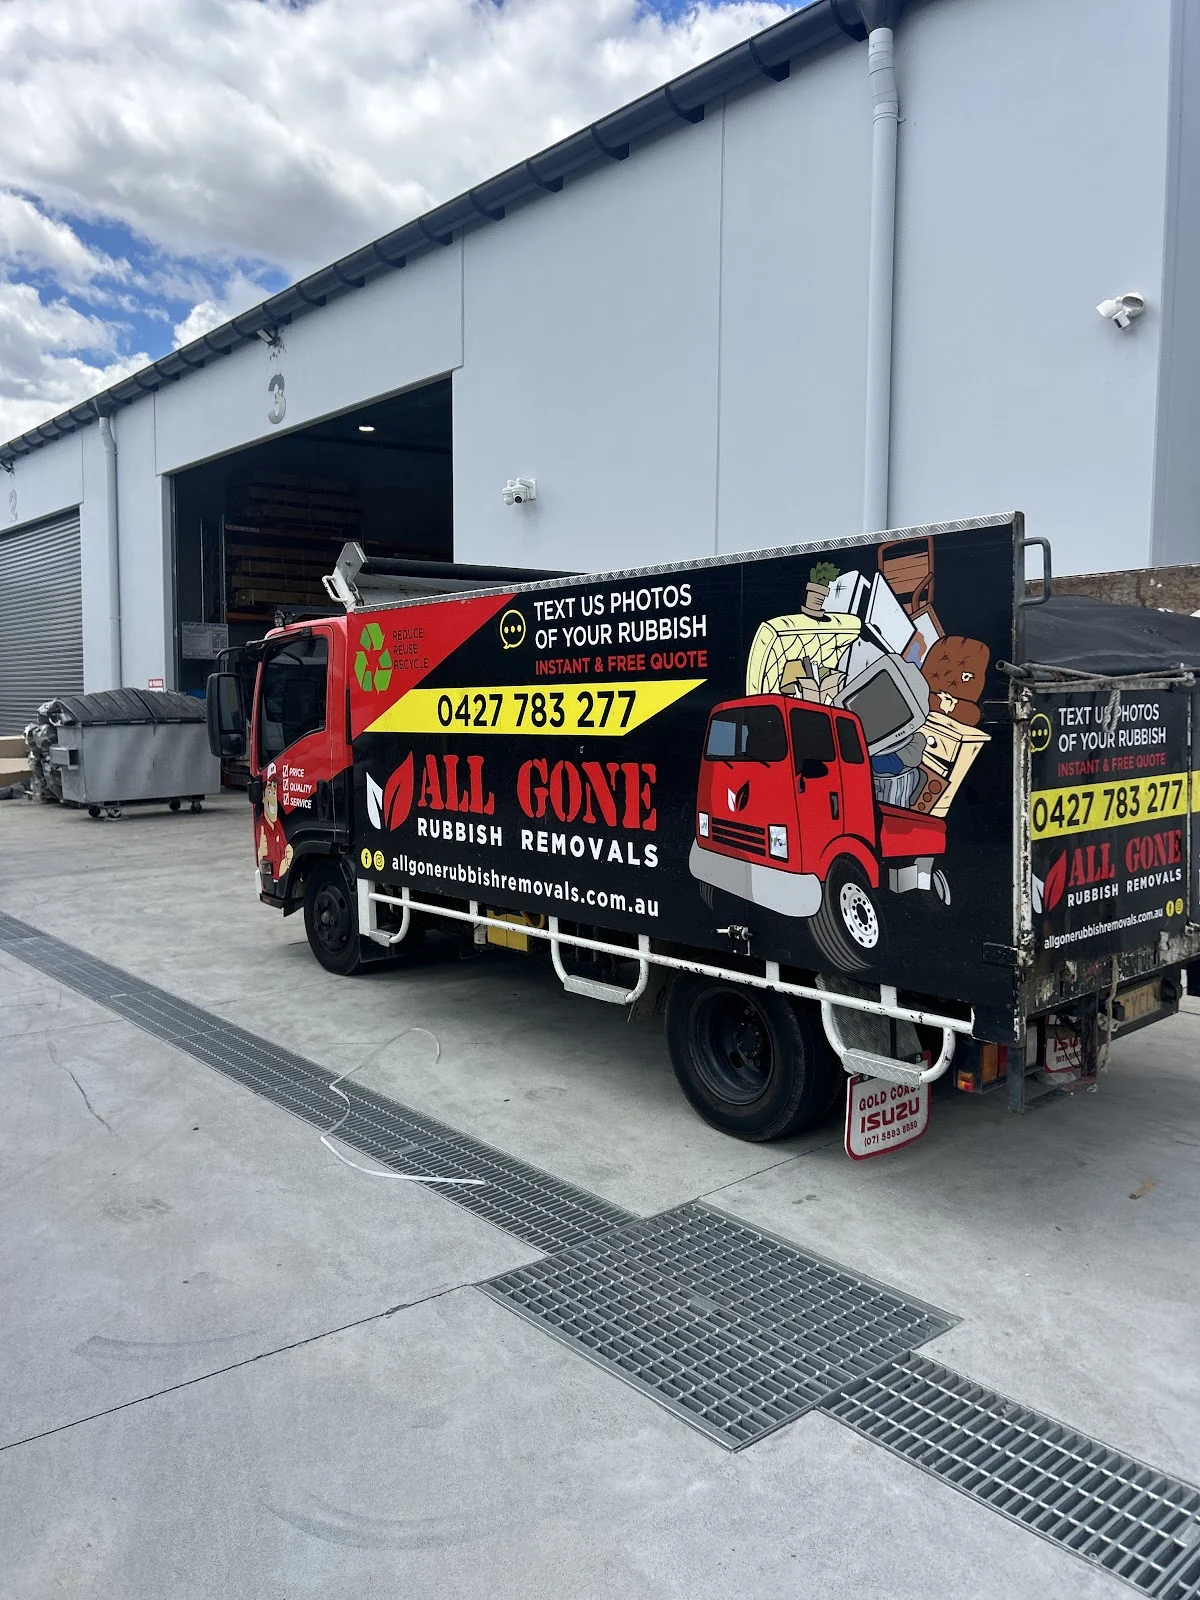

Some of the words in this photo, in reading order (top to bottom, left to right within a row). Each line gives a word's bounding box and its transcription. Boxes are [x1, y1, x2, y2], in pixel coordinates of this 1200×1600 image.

[267, 373, 287, 425] 3
[534, 597, 576, 622] TEXT
[581, 594, 604, 617] US
[610, 583, 692, 615] PHOTOS
[392, 627, 424, 641] REDUCE
[535, 629, 558, 650] OF
[562, 623, 612, 647] YOUR
[618, 614, 707, 643] RUBBISH
[393, 643, 419, 656] REUSE
[393, 657, 429, 670] RECYCLE
[535, 657, 591, 676] INSTANT
[595, 656, 604, 673] &
[607, 653, 646, 672] FREE
[651, 650, 708, 671] QUOTE
[437, 693, 504, 727] 0427
[513, 692, 565, 728] 783
[577, 690, 637, 728] 277
[1058, 706, 1092, 726] TEXT
[1058, 733, 1077, 753] OF
[1080, 732, 1115, 750] YOUR
[1118, 726, 1166, 748] RUBBISH
[290, 767, 305, 778] PRICE
[1057, 759, 1100, 778] INSTANT
[1102, 758, 1109, 772] &
[1112, 755, 1134, 772] FREE
[1136, 752, 1166, 769] QUOTE
[290, 782, 312, 794] QUALITY
[290, 797, 313, 809] SERVICE
[417, 754, 496, 815] ALL
[517, 758, 657, 832] GONE
[1032, 790, 1095, 832] 0427
[1104, 785, 1141, 821] 783
[1147, 779, 1183, 814] 277
[417, 817, 503, 847] RUBBISH
[521, 829, 660, 868] REMOVALS
[1067, 842, 1116, 888] ALL
[1125, 829, 1183, 873] GONE
[391, 854, 660, 918] allgonerubbishremovals.com.au
[1067, 882, 1119, 908] RUBBISH
[1126, 868, 1182, 894] REMOVALS
[1044, 907, 1164, 950] allgonerubbishremovals.com.au
[858, 1091, 887, 1112] GOLD
[860, 1096, 920, 1134] ISUZU
[864, 1134, 879, 1147] (07)
[881, 1127, 901, 1141] 5583
